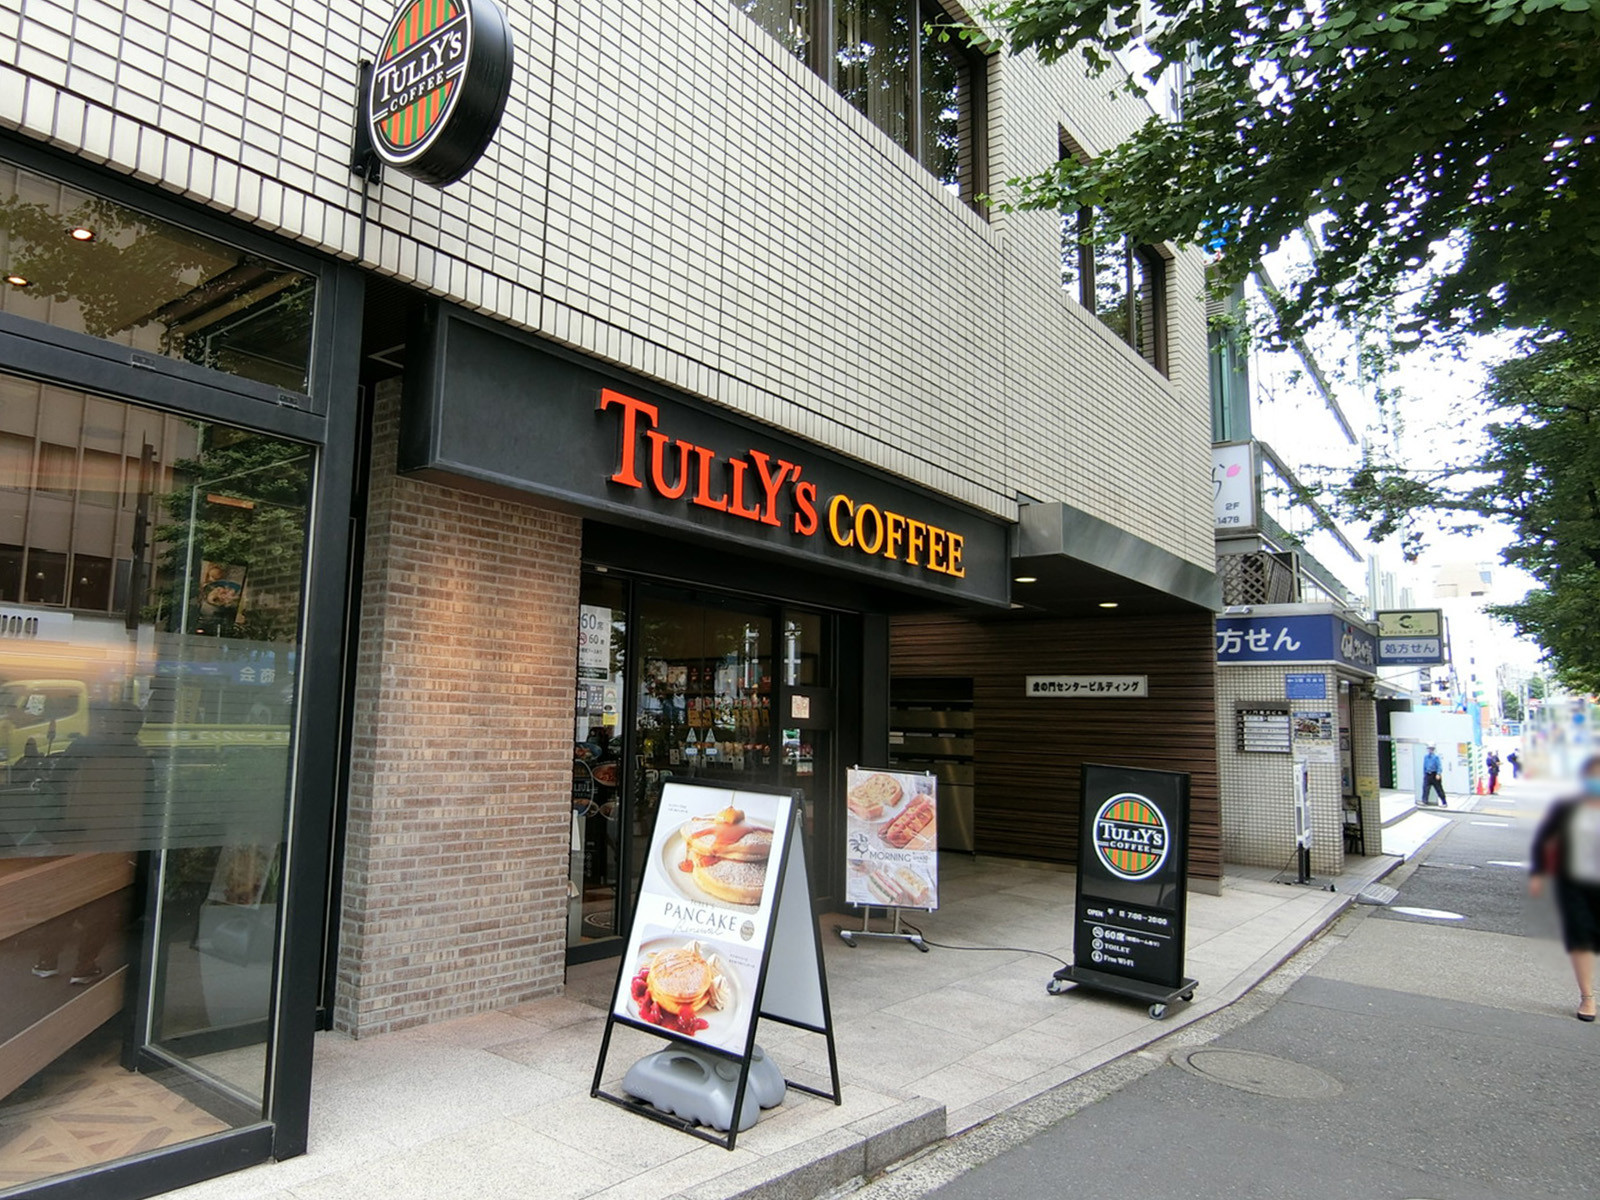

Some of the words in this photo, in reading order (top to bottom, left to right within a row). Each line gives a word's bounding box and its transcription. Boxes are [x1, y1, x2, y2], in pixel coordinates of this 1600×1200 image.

[378, 30, 462, 103] TULLY'S
[390, 70, 444, 112] COFFEE
[599, 387, 818, 536] TULLY'S
[828, 494, 965, 578] COFFEE
[1225, 501, 1240, 511] 2F
[1385, 643, 1436, 654] 処方せん
[1099, 822, 1162, 846] TULLY'S
[1110, 840, 1150, 853] COFFEE
[870, 851, 912, 863] MORNING
[664, 902, 738, 931] PANCAKE
[1087, 908, 1103, 917] OPEN
[1104, 943, 1130, 954] TOILET
[1103, 954, 1117, 964] Free
